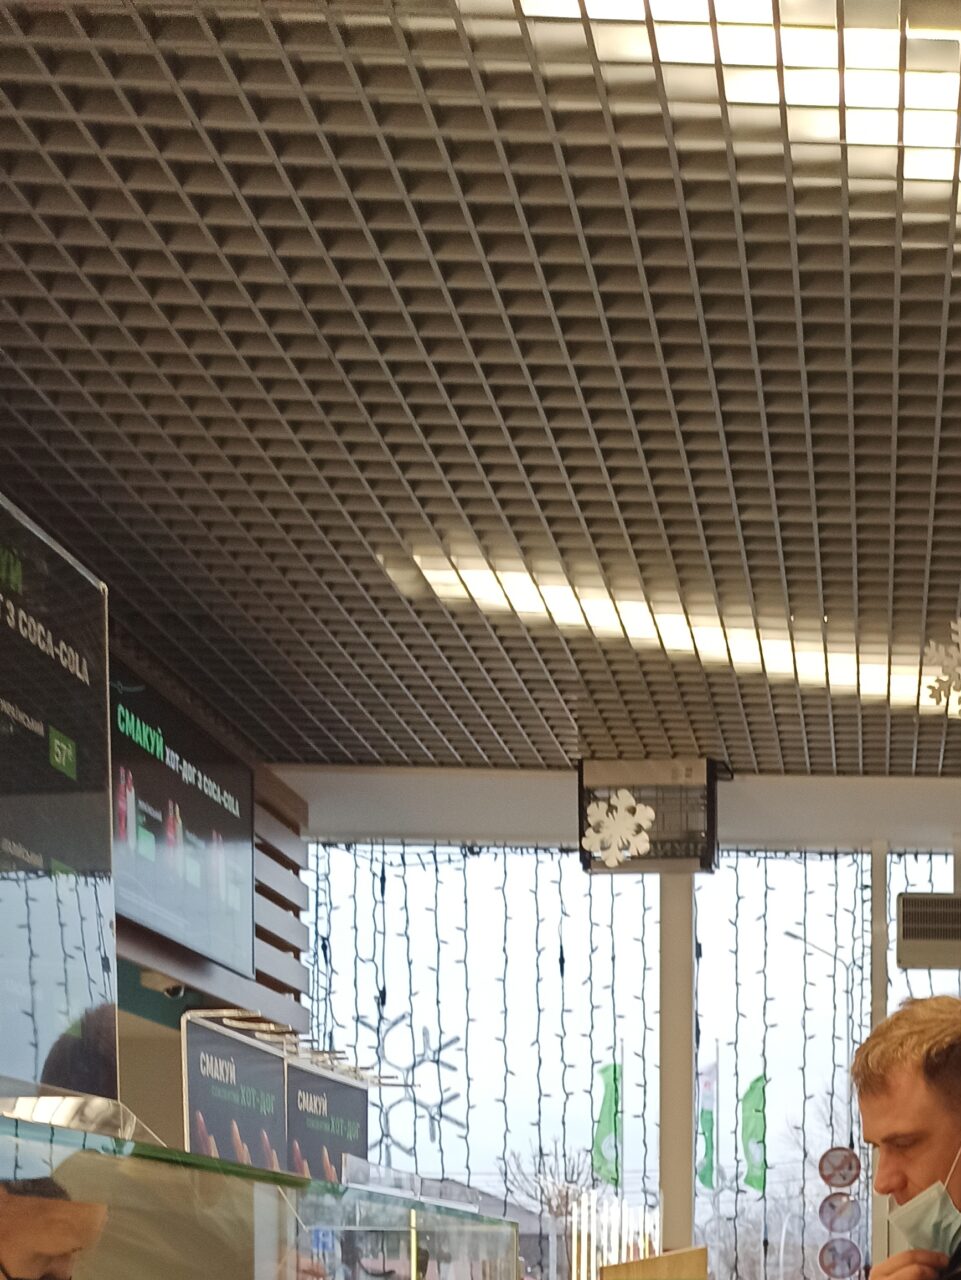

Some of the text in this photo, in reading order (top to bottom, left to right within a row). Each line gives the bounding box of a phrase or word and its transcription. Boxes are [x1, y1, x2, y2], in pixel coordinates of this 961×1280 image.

[18, 607, 90, 686] COCA-COLA
[117, 703, 164, 762] СМАКУЙ
[165, 744, 197, 785] ХОТ-ДОГ
[203, 774, 241, 819] COCA-COLA
[199, 1051, 237, 1086] СМАКУЙ
[240, 1084, 276, 1117] ХОТ-ДОГ
[297, 1089, 328, 1117] СМАКУЙ
[330, 1116, 361, 1142] ХОТ-ДОГ
